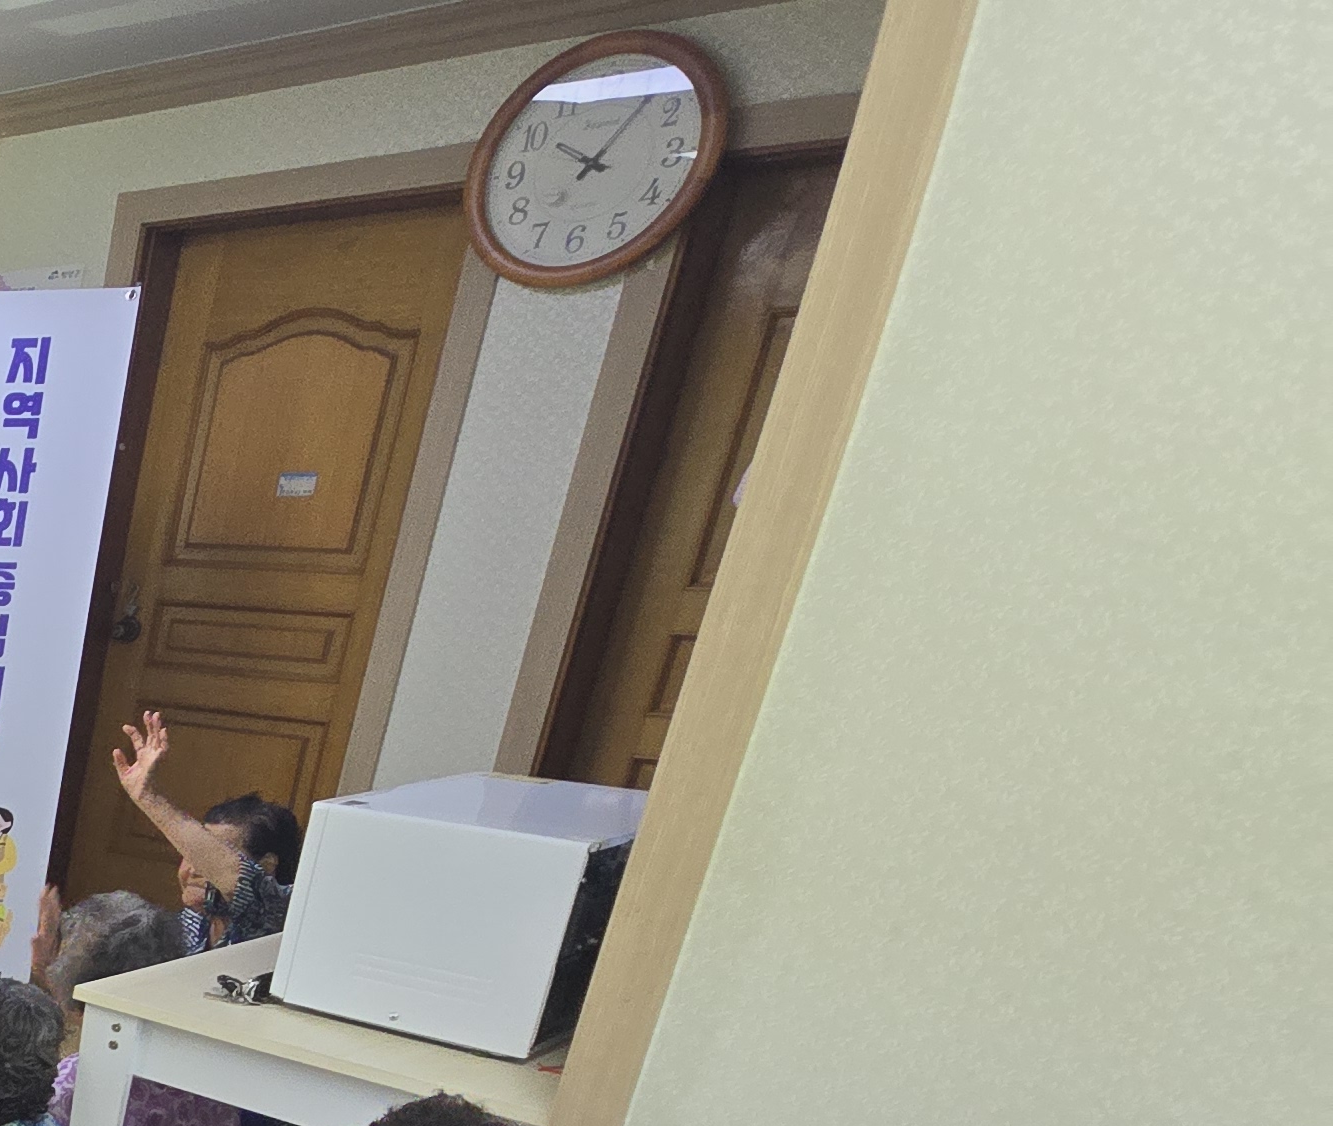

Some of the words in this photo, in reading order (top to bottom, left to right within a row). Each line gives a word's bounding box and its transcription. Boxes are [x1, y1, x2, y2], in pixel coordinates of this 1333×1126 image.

[661, 97, 682, 128] 2
[523, 119, 549, 153] 10
[661, 136, 685, 168] 3
[504, 160, 526, 190] 9
[638, 177, 663, 206] 4
[508, 196, 530, 225] 8
[533, 220, 550, 249] 7
[565, 225, 587, 253] 6
[606, 211, 628, 240] 5
